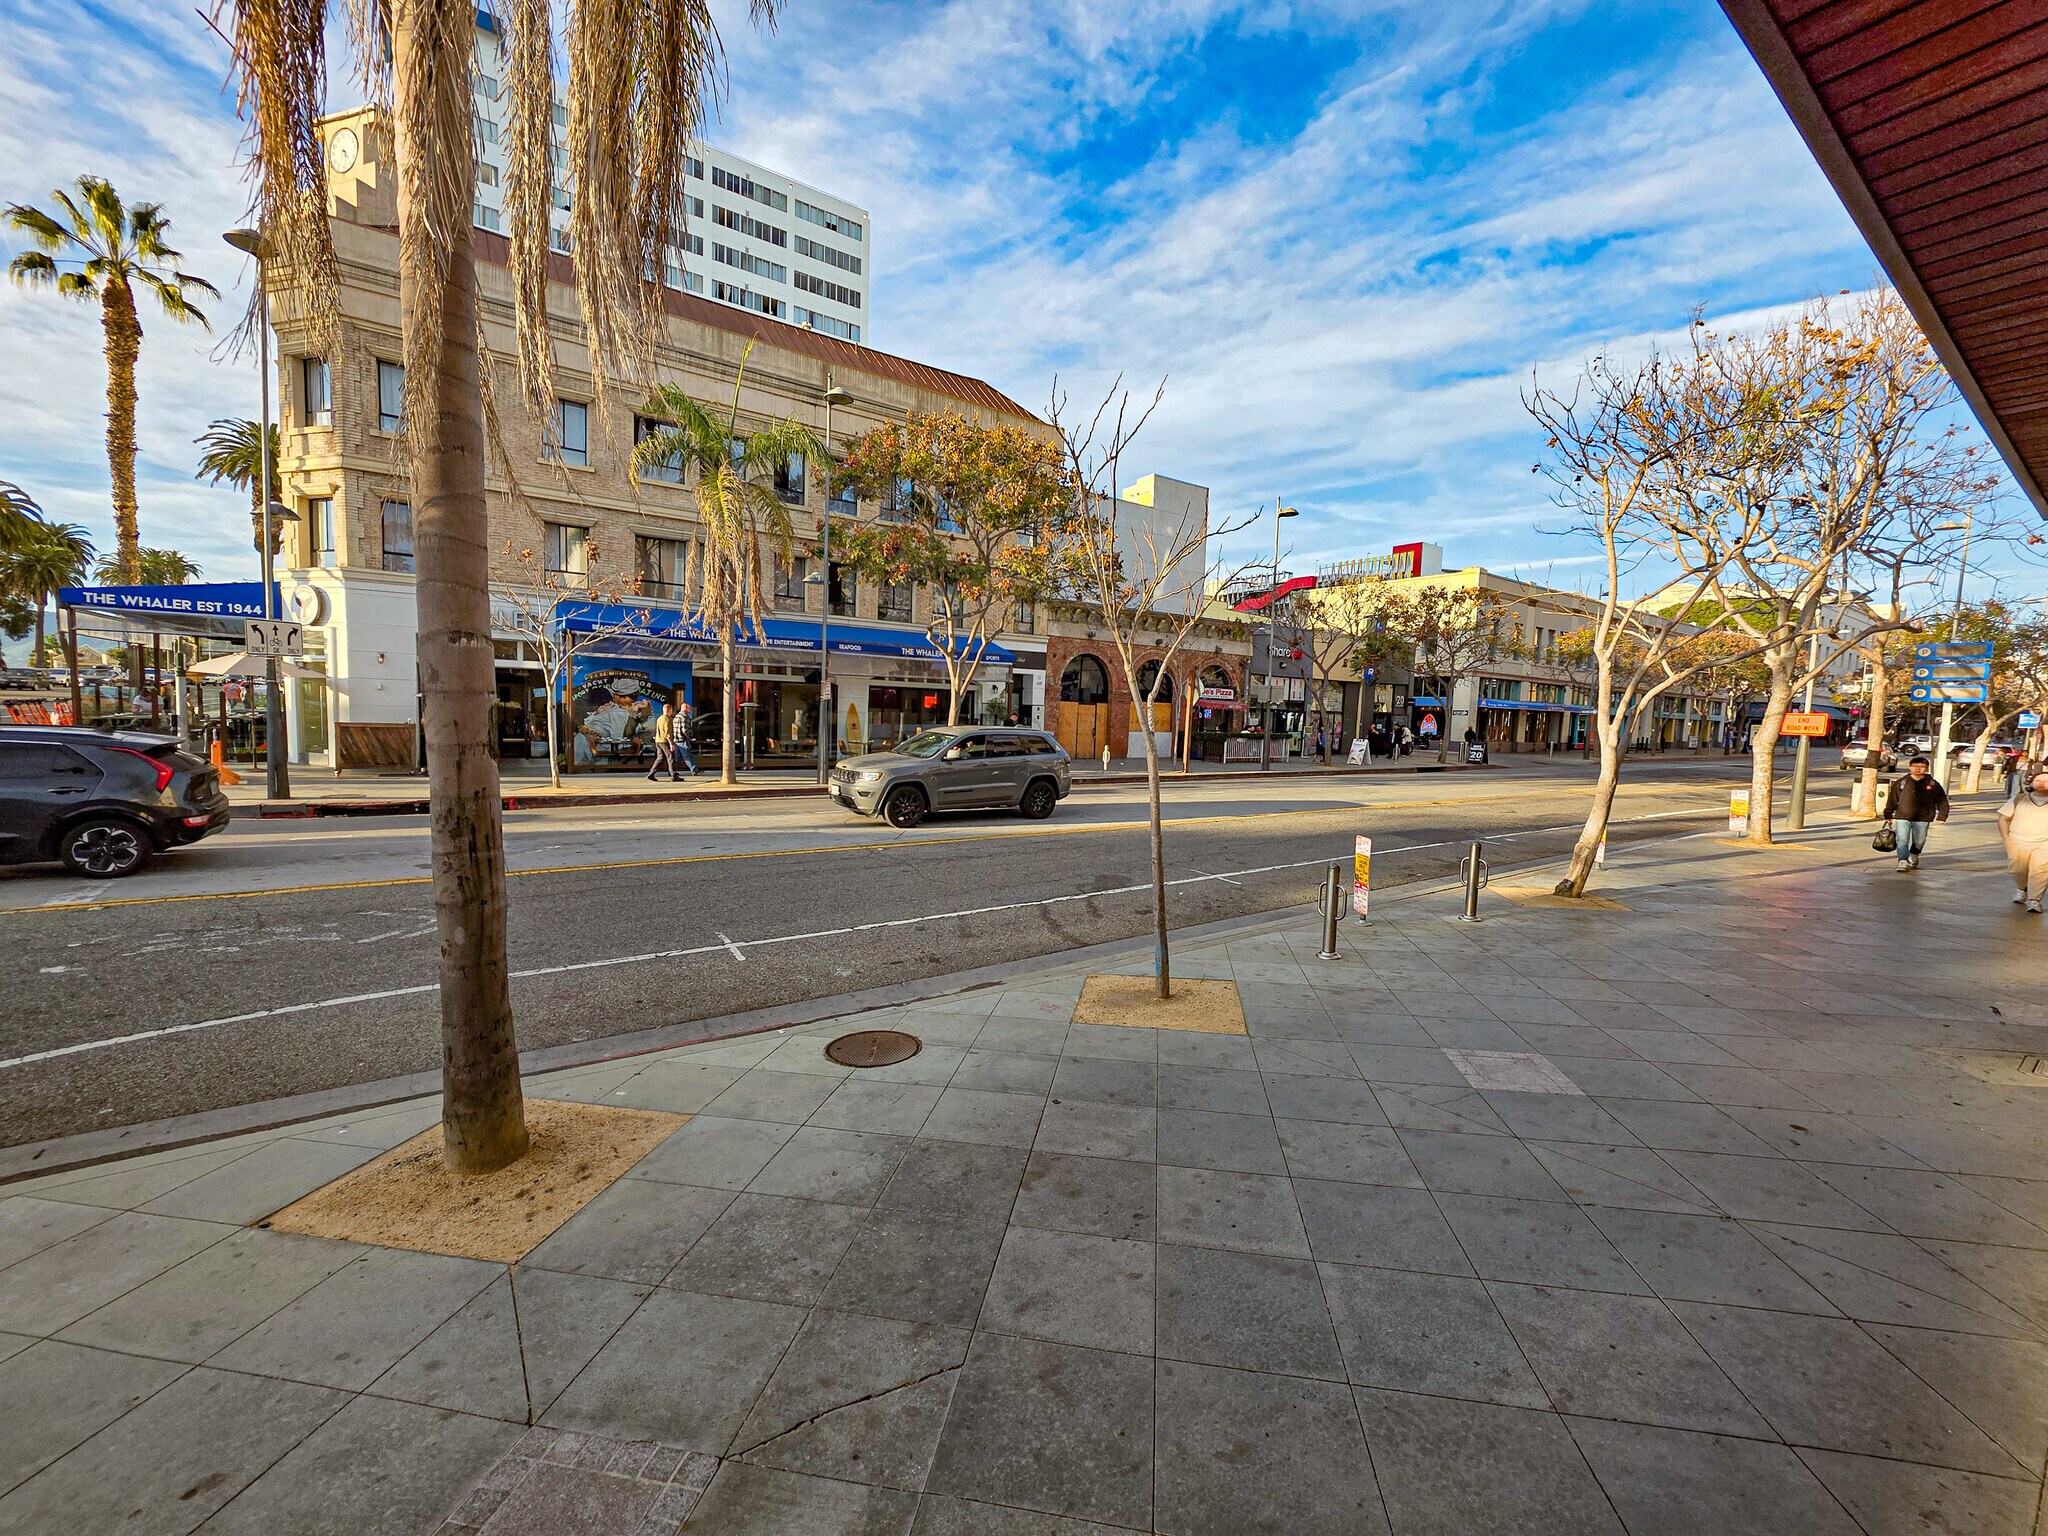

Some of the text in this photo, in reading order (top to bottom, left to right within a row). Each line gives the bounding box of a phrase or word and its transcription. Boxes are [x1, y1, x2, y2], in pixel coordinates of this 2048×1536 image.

[83, 592, 262, 615] THE WHALER EST 1944
[670, 628, 687, 638] THE
[774, 639, 814, 647] ENTERTAINMENT
[838, 643, 862, 651] SEAFOOD
[901, 648, 914, 656] THE
[582, 679, 608, 689] YACHT
[1216, 689, 1232, 697] Pizza
